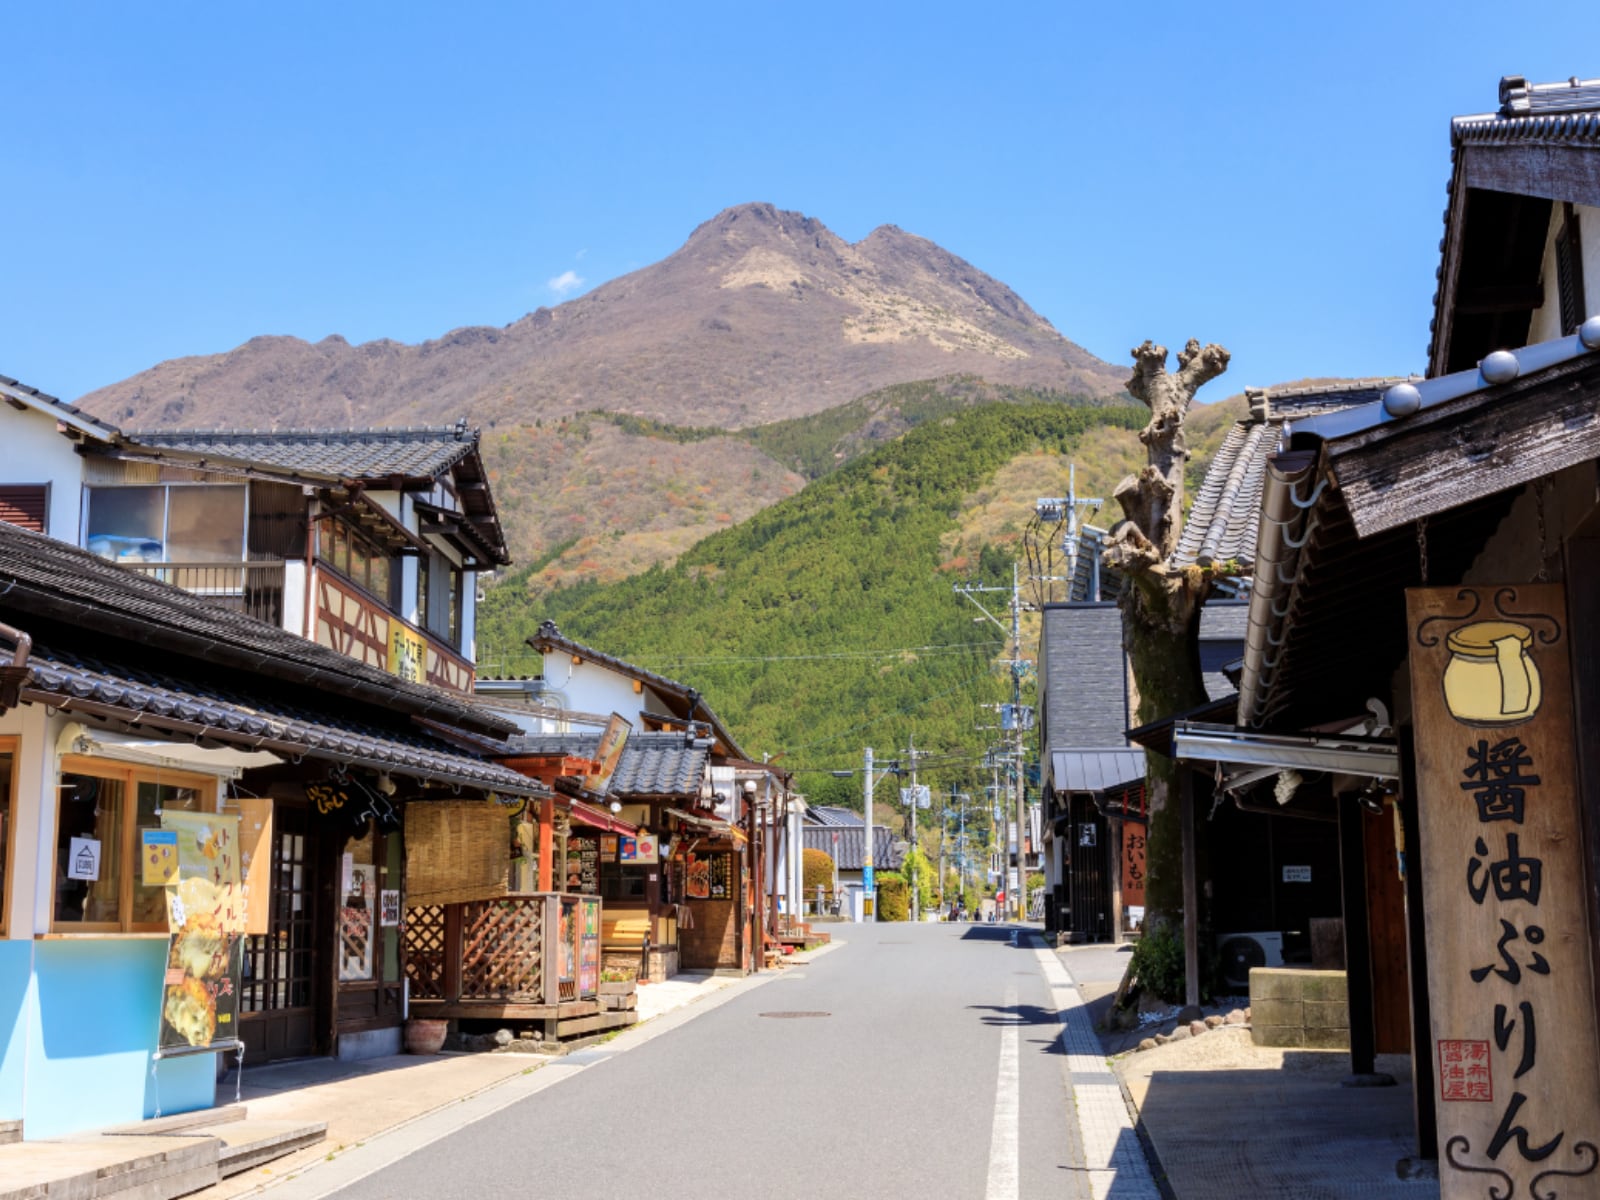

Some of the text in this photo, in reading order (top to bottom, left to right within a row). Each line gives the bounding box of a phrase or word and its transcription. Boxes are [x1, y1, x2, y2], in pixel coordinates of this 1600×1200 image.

[1126, 833, 1145, 880] おいも
[1460, 737, 1564, 1162] 醤油ぷりん
[1464, 1042, 1489, 1098] 湯布院
